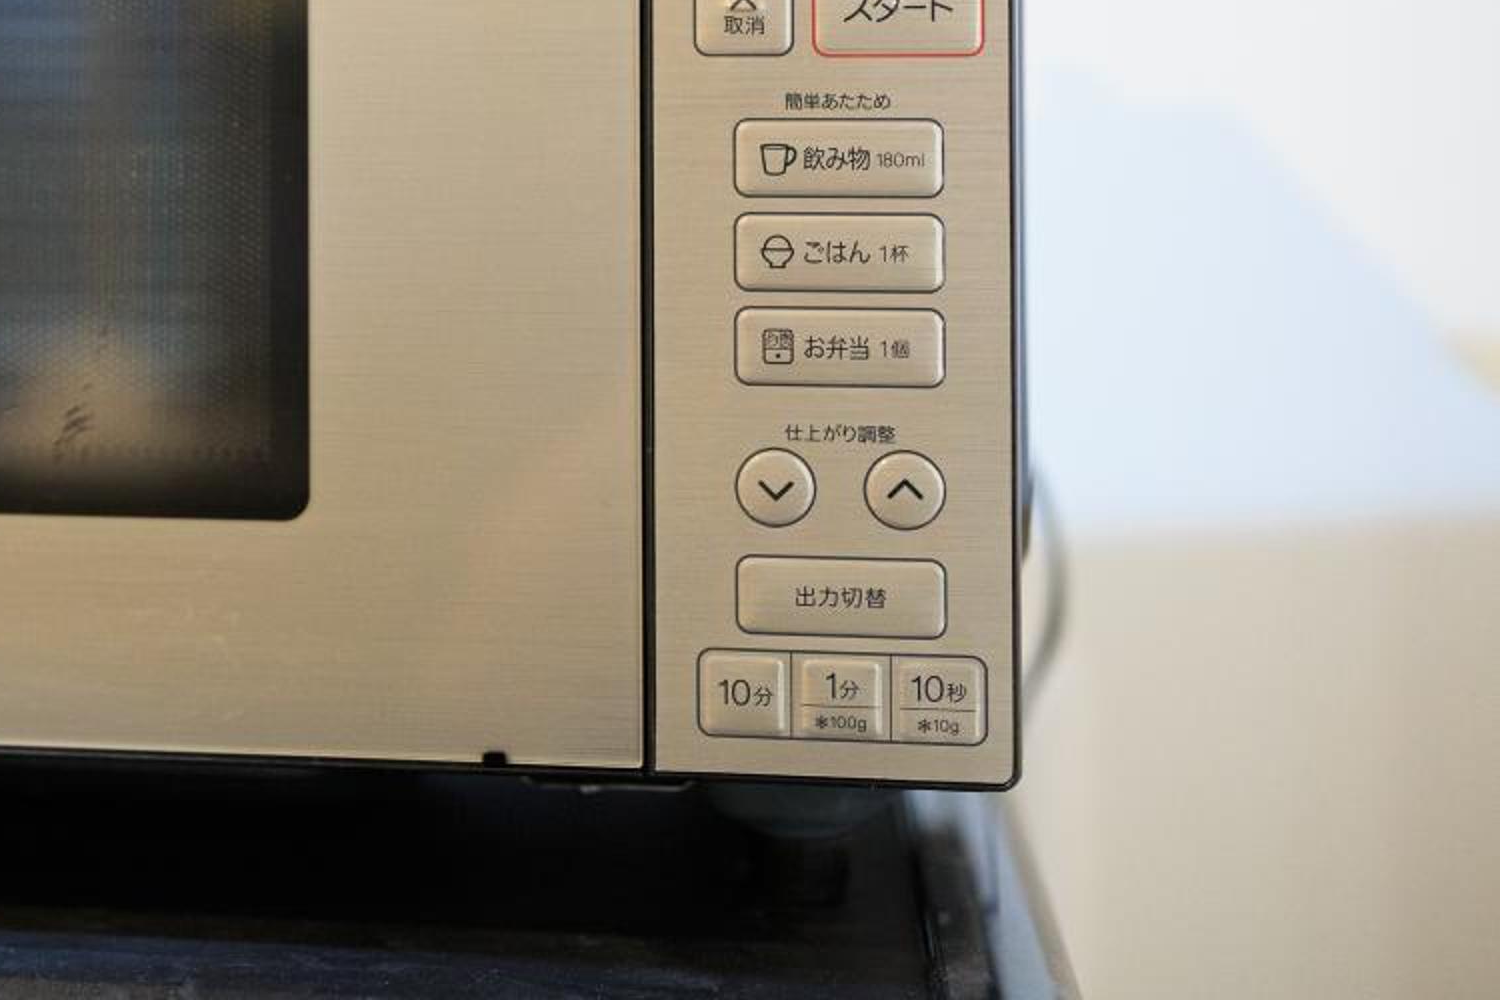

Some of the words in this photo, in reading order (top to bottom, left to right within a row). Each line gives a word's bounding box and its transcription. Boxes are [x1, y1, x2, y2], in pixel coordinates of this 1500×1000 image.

[723, 14, 765, 35] 取消
[784, 92, 892, 111] 簡単あたため
[802, 146, 871, 171] 飲み物
[876, 151, 926, 168] 180ml
[803, 240, 871, 264] ごはん
[879, 245, 910, 263] 1杯
[803, 336, 870, 360] お弁当
[881, 340, 911, 359] 1個
[784, 423, 897, 444] 仕上がり調整
[794, 586, 887, 610] 出力切替
[718, 678, 774, 707] 10分
[825, 672, 860, 701] 1分
[911, 674, 968, 704] 10秒
